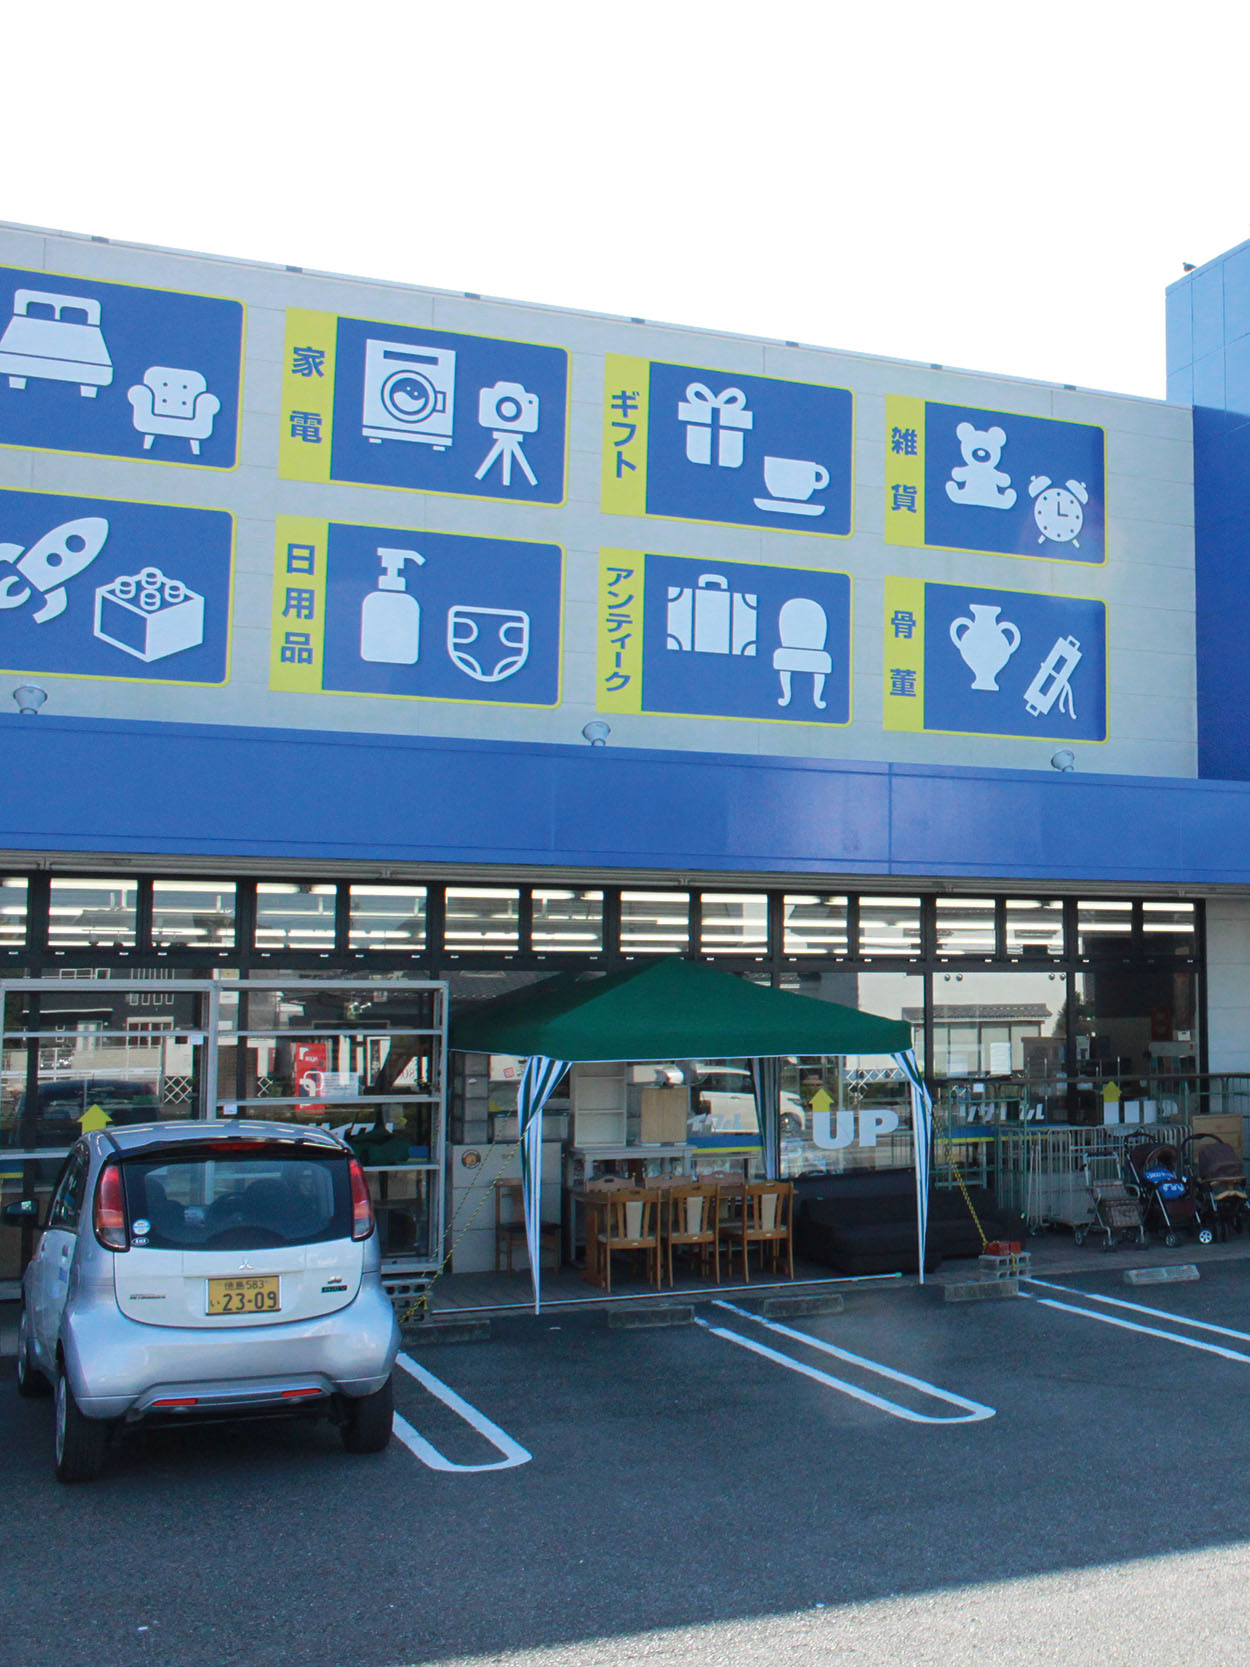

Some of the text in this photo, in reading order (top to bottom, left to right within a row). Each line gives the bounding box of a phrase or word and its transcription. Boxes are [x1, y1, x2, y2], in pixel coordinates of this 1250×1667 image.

[289, 346, 325, 444] 家電
[611, 390, 639, 478] ギフト
[890, 426, 918, 513] 雑貨
[280, 542, 316, 665] 日用品
[604, 567, 635, 692] アンティーク
[889, 610, 918, 698] 骨董
[813, 1109, 899, 1149] UP
[223, 1291, 277, 1311] 23-09
[246, 1280, 264, 1290] 583
